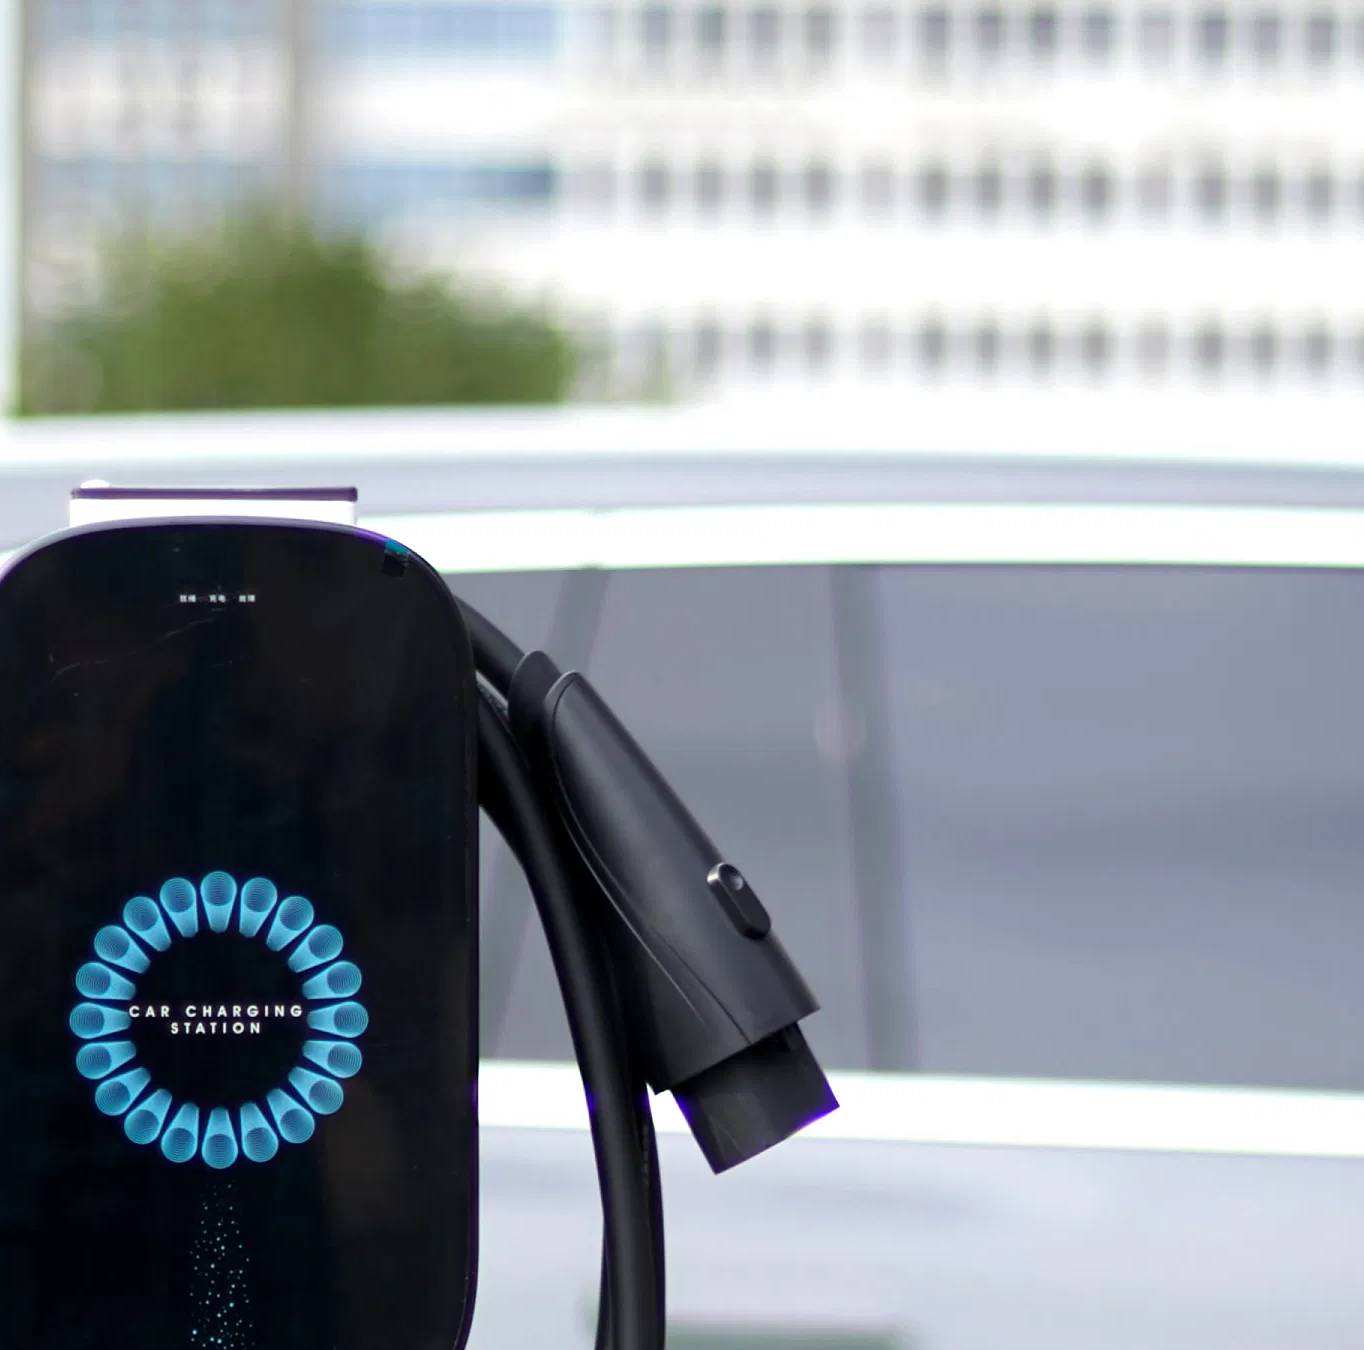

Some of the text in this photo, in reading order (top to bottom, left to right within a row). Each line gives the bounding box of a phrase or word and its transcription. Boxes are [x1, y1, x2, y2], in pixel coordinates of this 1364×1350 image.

[128, 1005, 303, 1018] CAR CHARGING
[170, 1022, 261, 1035] STATION
